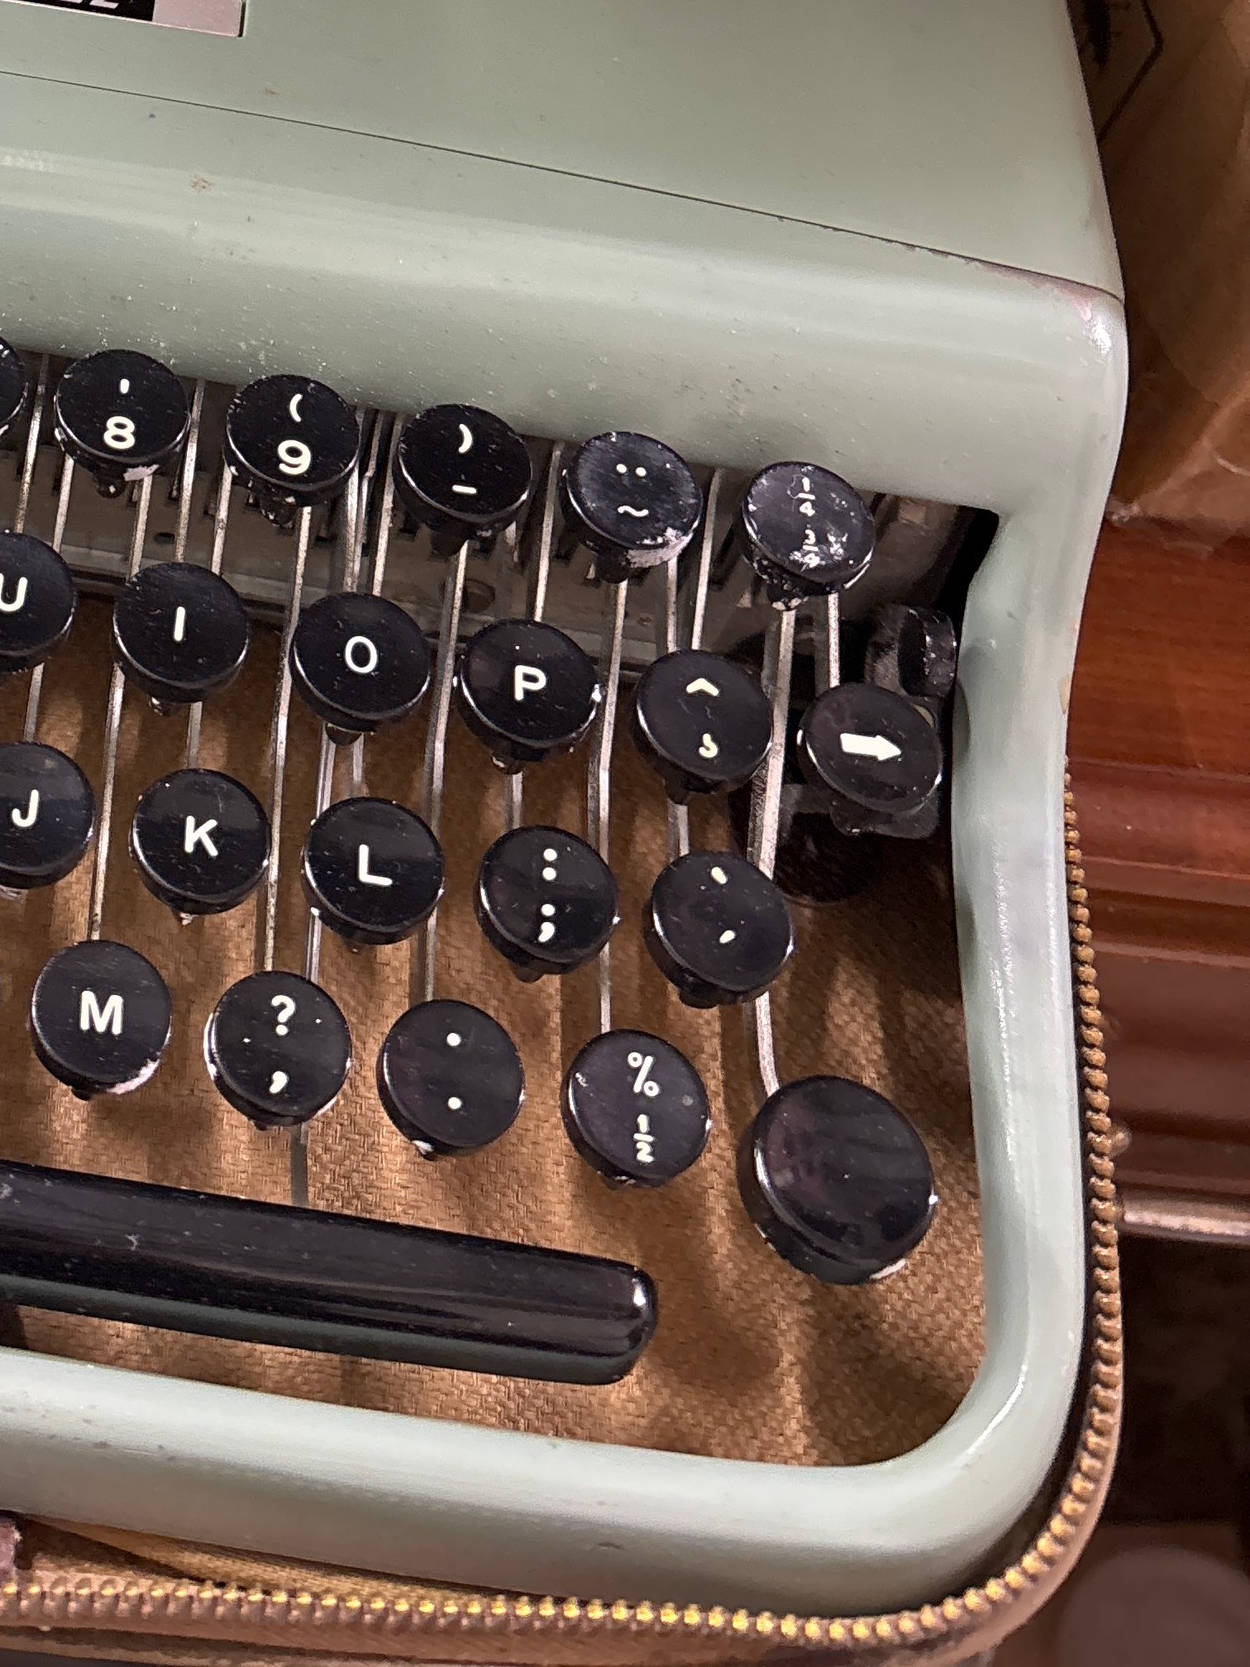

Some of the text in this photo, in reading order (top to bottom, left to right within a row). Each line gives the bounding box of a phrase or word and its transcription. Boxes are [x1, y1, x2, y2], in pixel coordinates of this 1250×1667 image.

[104, 416, 136, 449] 8
[277, 441, 311, 475] 9
[345, 637, 378, 674] O
[514, 666, 547, 701] P
[11, 789, 39, 828] J
[184, 816, 218, 857] K
[358, 844, 392, 886] L
[79, 991, 124, 1035] M
[271, 995, 296, 1036] ?
[627, 1052, 659, 1097] %
